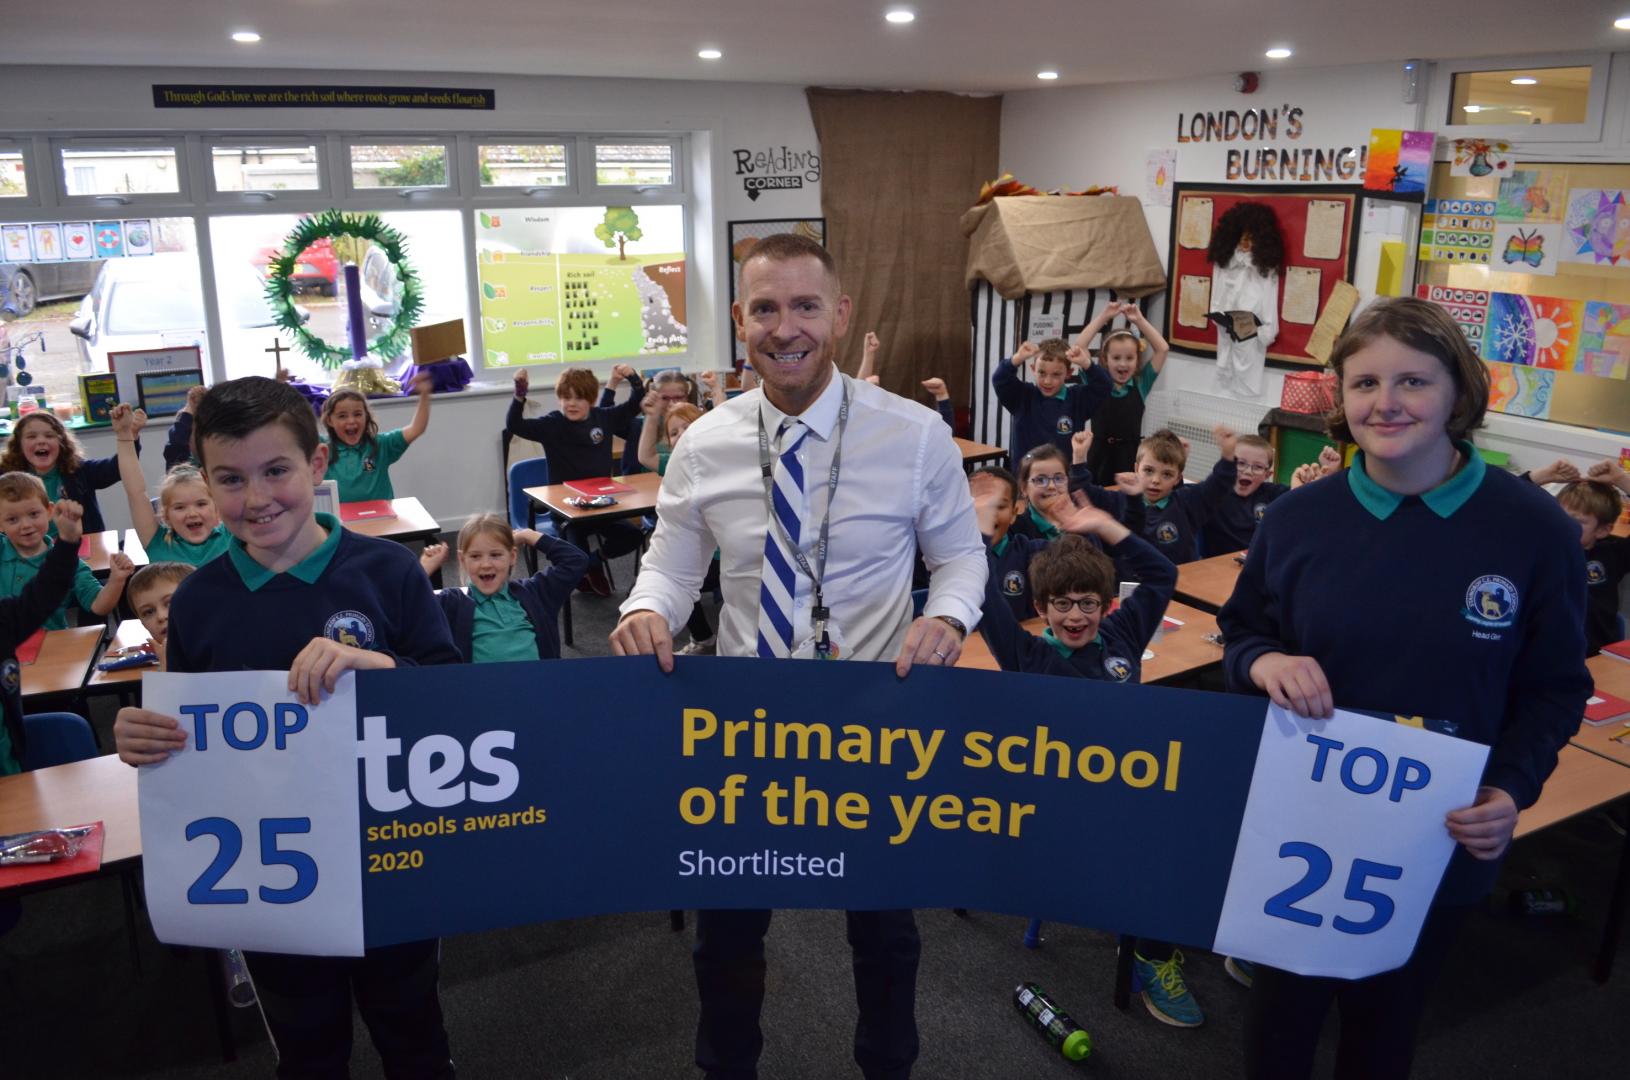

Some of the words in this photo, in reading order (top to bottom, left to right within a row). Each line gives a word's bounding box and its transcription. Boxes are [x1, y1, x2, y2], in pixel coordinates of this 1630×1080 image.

[164, 90, 205, 104] Through
[253, 93, 268, 102] we
[268, 93, 284, 102] are
[284, 91, 300, 102] the
[301, 90, 319, 102] rich
[320, 91, 335, 102] soil
[336, 91, 364, 102] where
[365, 93, 387, 103] roots
[387, 94, 411, 104] grow
[411, 92, 429, 103] and
[429, 92, 452, 104] seeds
[452, 92, 486, 104] flourish
[1177, 103, 1303, 143] LONDON'S
[1225, 145, 1367, 181] BURNING!
[746, 177, 800, 189] CORNER
[658, 266, 681, 274] Reflect
[1472, 630, 1490, 639] Head
[179, 701, 308, 751] TOP
[356, 715, 520, 812] tes
[682, 708, 946, 781] Primary
[963, 725, 1182, 792] school
[1306, 734, 1432, 803] TOP
[366, 814, 456, 842] schools
[463, 805, 546, 833] awards
[679, 774, 747, 825] of
[761, 776, 871, 830] the
[888, 793, 1036, 845] year
[184, 816, 319, 905] 25
[368, 849, 424, 873] 2020
[678, 850, 845, 878] Shortlisted
[1263, 841, 1404, 935] 25
